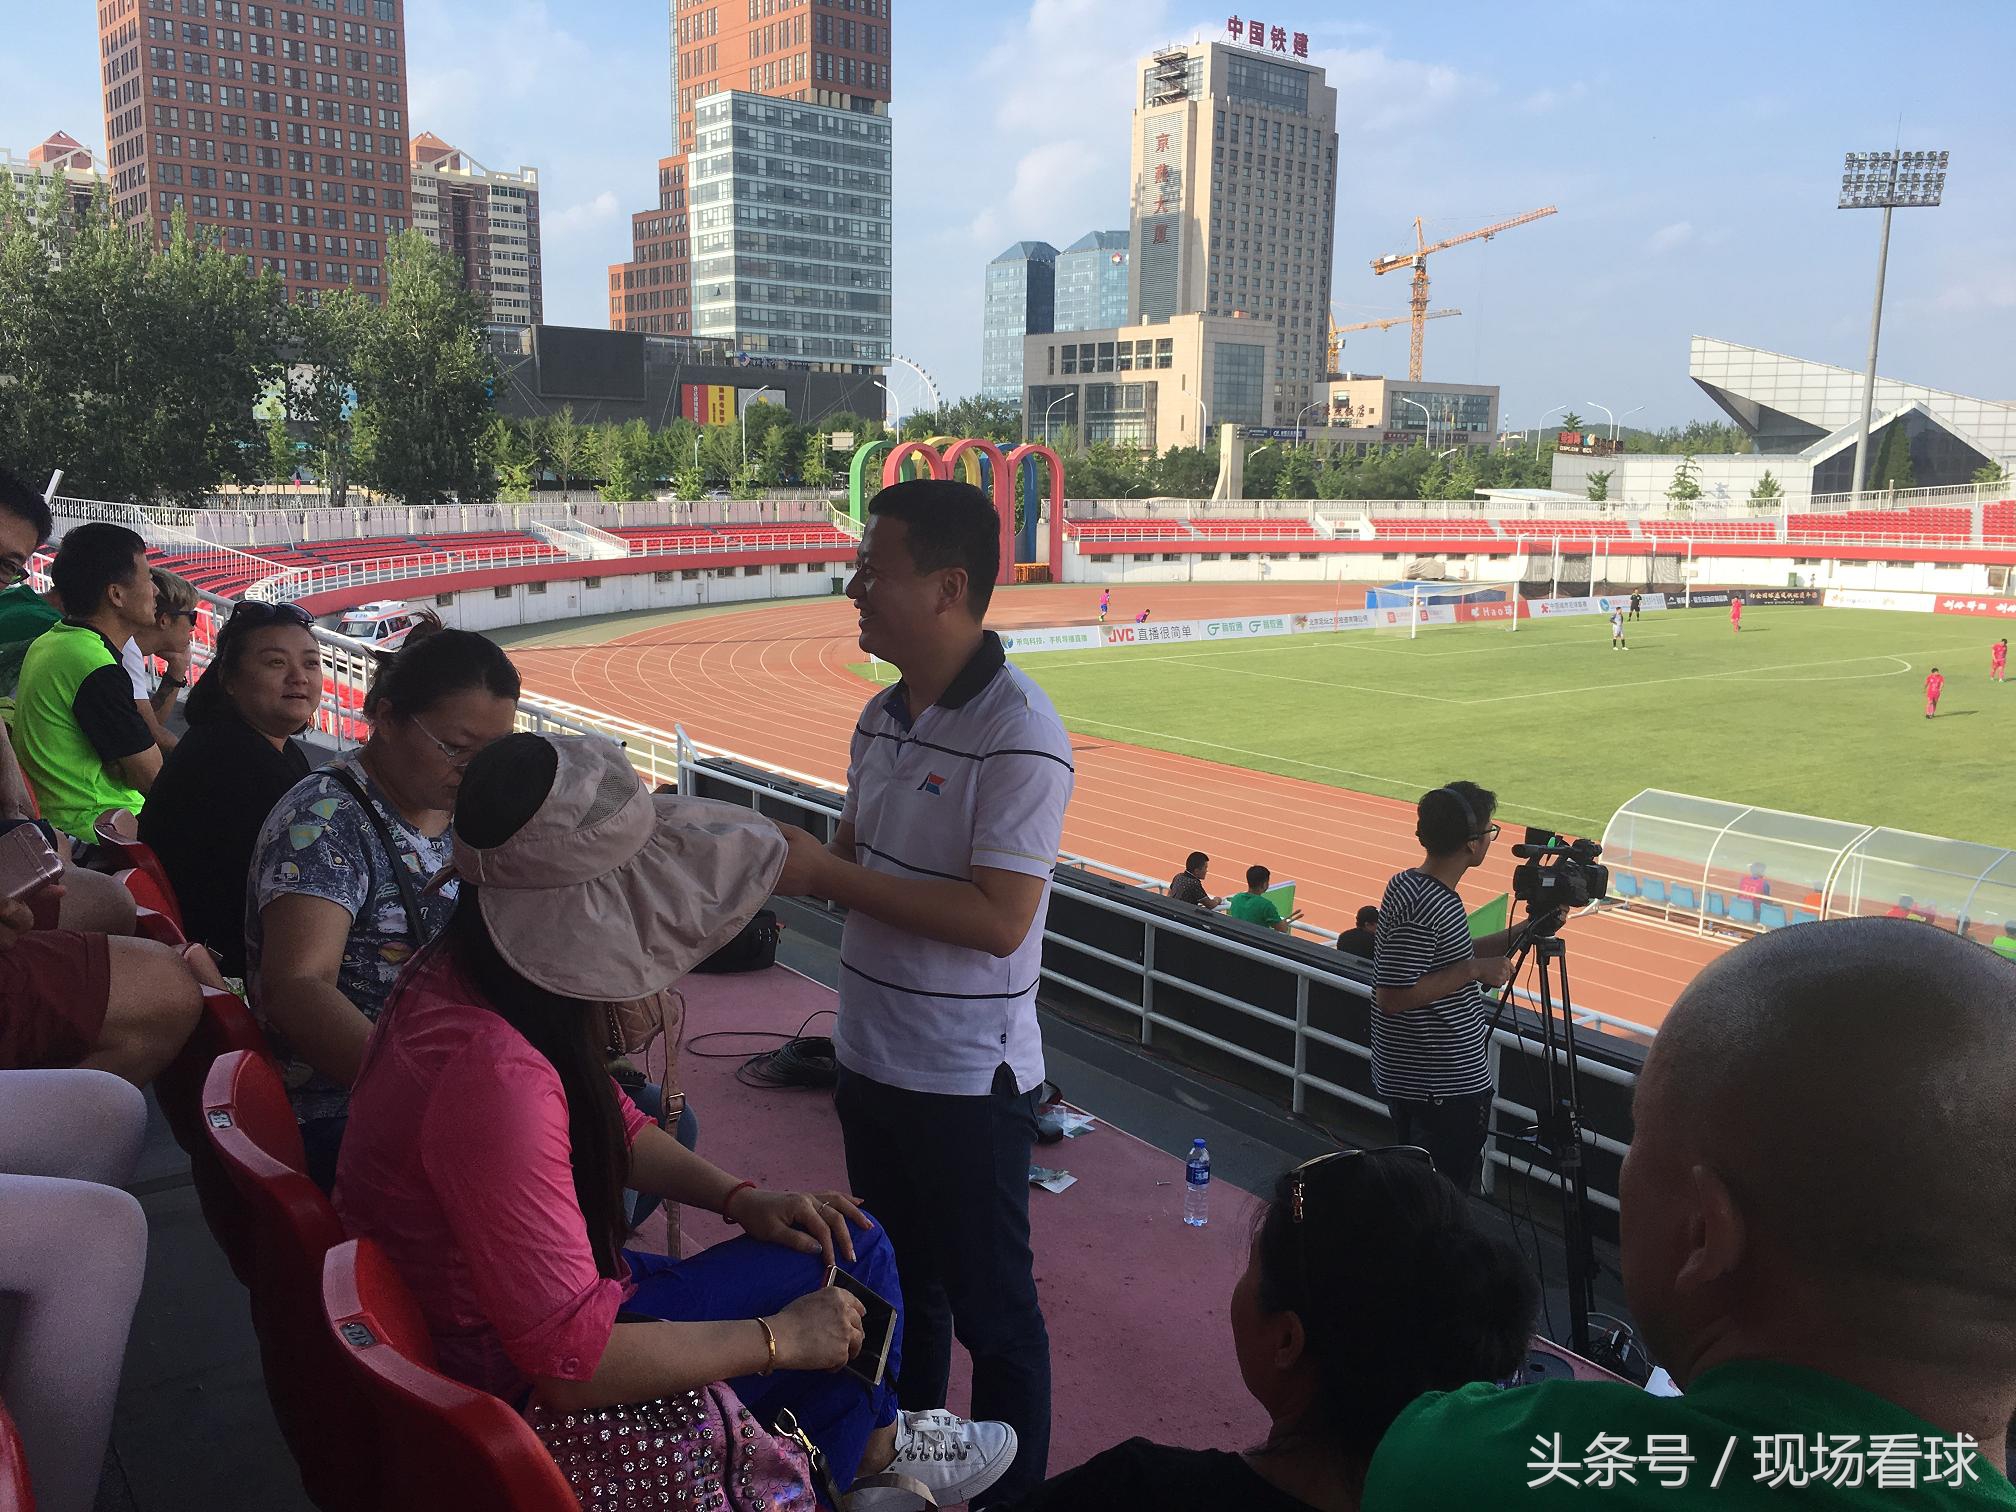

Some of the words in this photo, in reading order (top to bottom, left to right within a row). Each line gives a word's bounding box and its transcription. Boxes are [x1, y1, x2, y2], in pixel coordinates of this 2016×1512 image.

[1227, 15, 1308, 58] 中国铁建
[1108, 628, 1135, 643] JVC
[1137, 624, 1192, 641] 直播很简单
